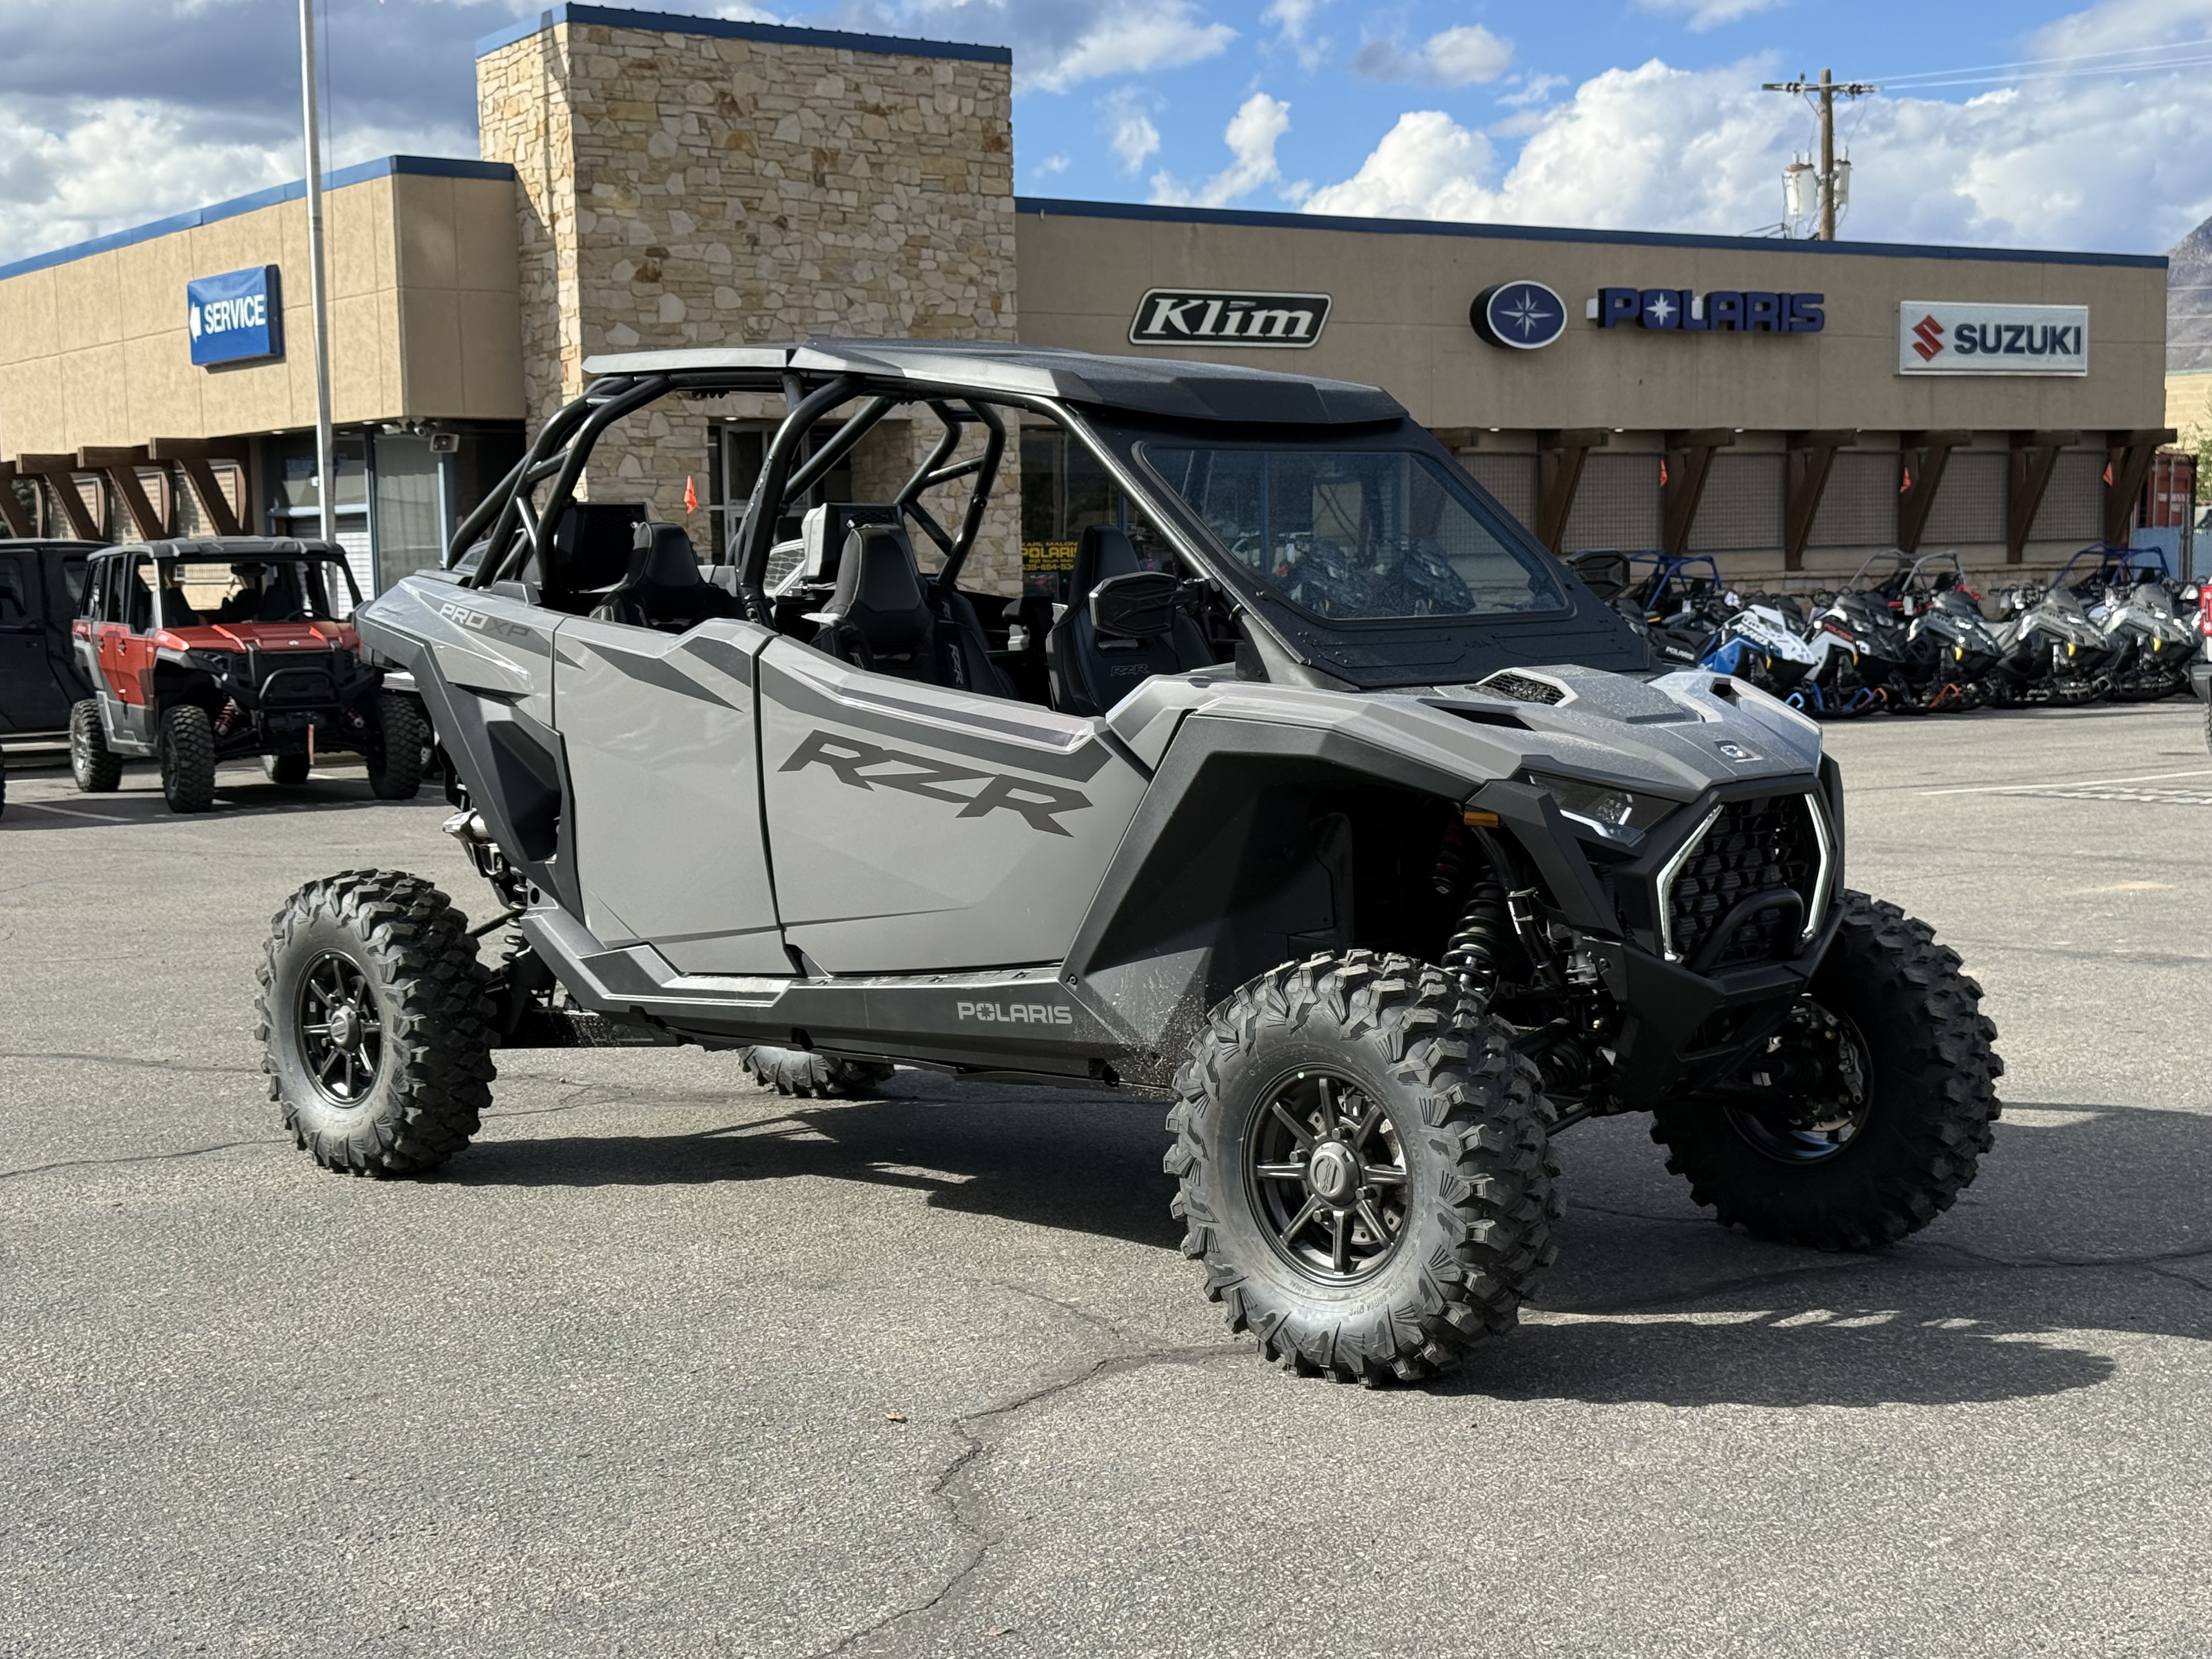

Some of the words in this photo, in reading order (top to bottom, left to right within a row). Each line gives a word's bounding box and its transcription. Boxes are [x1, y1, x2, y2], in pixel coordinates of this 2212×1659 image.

[204, 294, 267, 335] SERVICE
[1598, 287, 1825, 333] POLARIS
[1954, 323, 2081, 355] SUZUKI
[439, 602, 489, 630] PRO
[487, 619, 530, 637] XP
[1110, 663, 1150, 677] RZR
[777, 729, 1093, 838] RZR
[957, 1001, 1073, 1025] POLARIS
